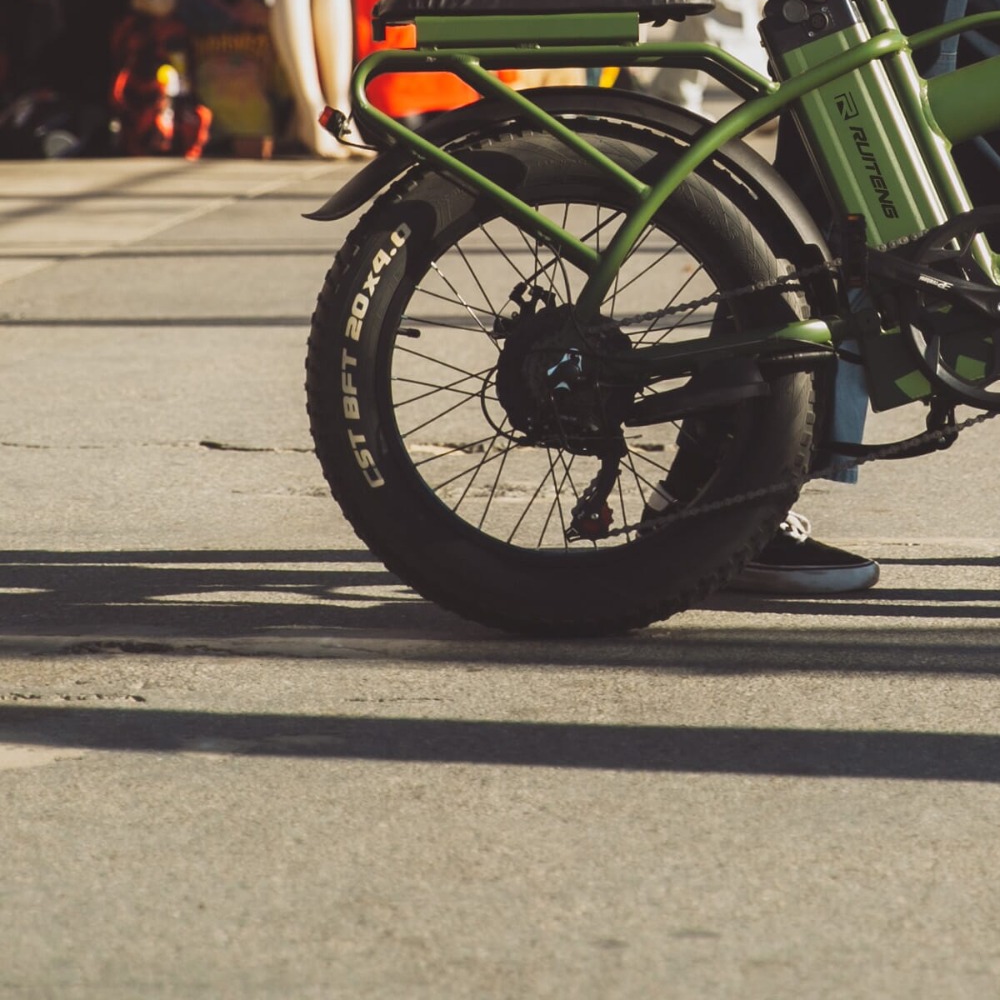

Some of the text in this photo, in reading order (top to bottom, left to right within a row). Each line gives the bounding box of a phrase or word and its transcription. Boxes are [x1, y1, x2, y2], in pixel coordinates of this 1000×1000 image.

[849, 126, 899, 219] RUITENG
[341, 347, 360, 420] BFT
[347, 428, 385, 488] CST
